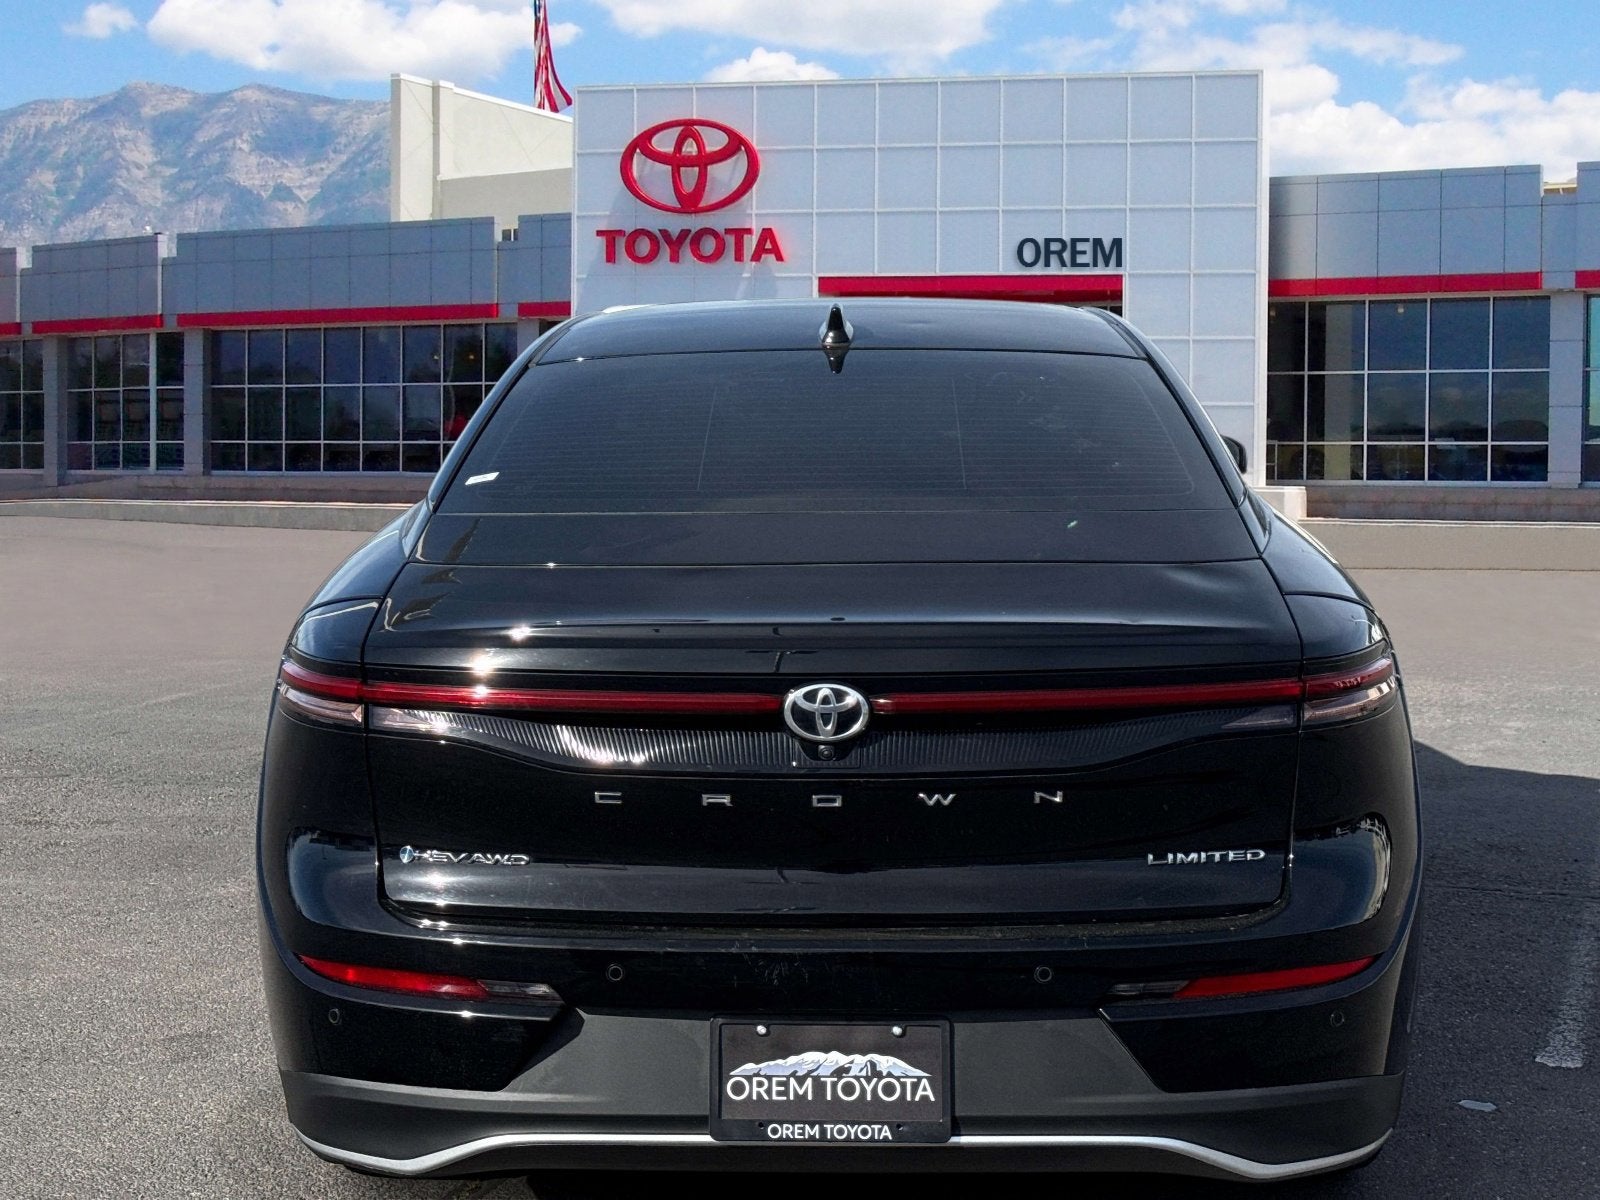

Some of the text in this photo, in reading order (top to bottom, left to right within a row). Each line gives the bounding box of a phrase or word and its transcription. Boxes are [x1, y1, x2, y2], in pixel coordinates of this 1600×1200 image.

[595, 226, 785, 265] TOYOTA
[1016, 237, 1123, 269] OREM
[594, 790, 1064, 808] CROWN
[1147, 849, 1266, 866] LIMITED
[726, 1076, 936, 1102] OREM TOYOTA
[767, 1123, 892, 1140] OREM TOYOTA
